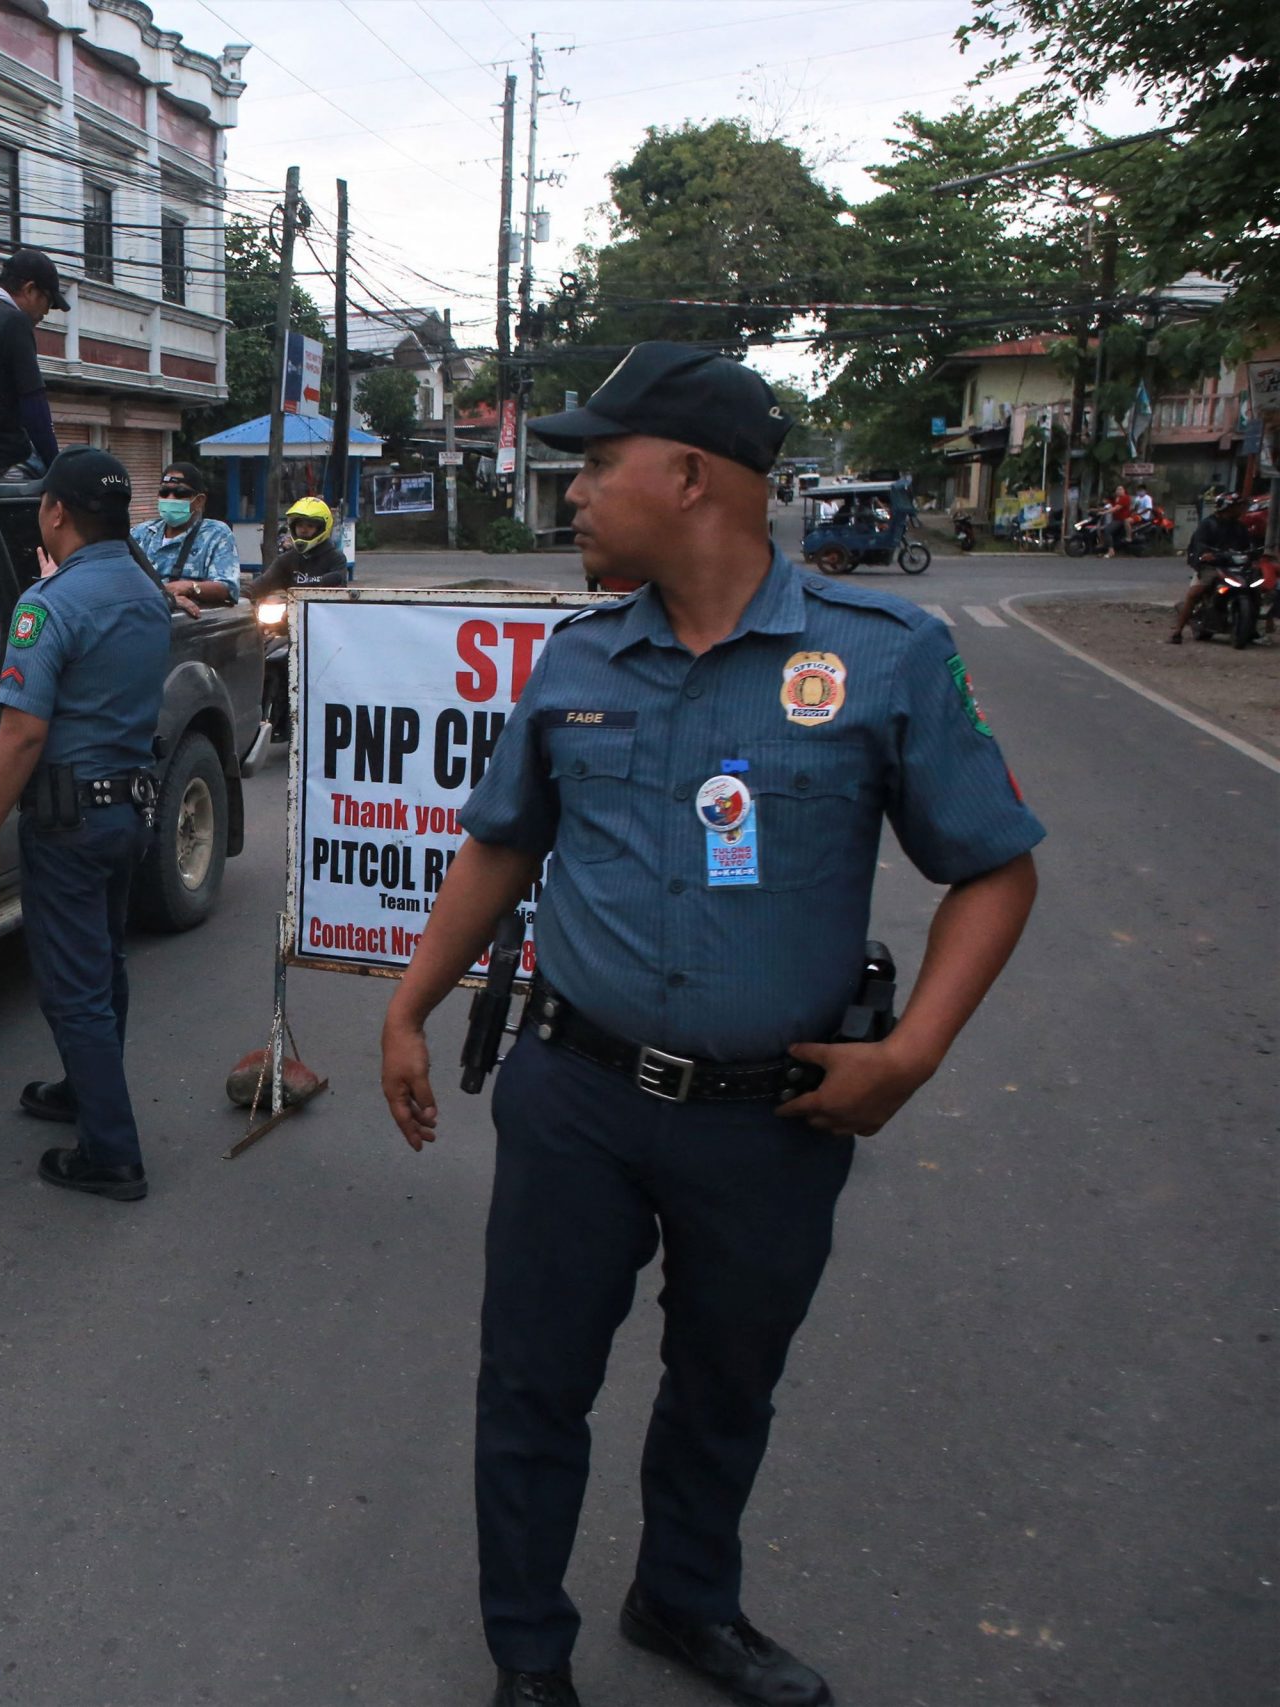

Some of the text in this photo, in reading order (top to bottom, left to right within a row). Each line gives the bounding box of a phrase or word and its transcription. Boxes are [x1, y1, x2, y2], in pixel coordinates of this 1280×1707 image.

[792, 662, 837, 675] OFFICER
[566, 711, 605, 724] FABE
[324, 703, 420, 785] PNP
[331, 793, 463, 836] Thank you
[312, 836, 456, 893] PLTCOL R
[379, 892, 420, 913] Team
[309, 916, 387, 954] Contact
